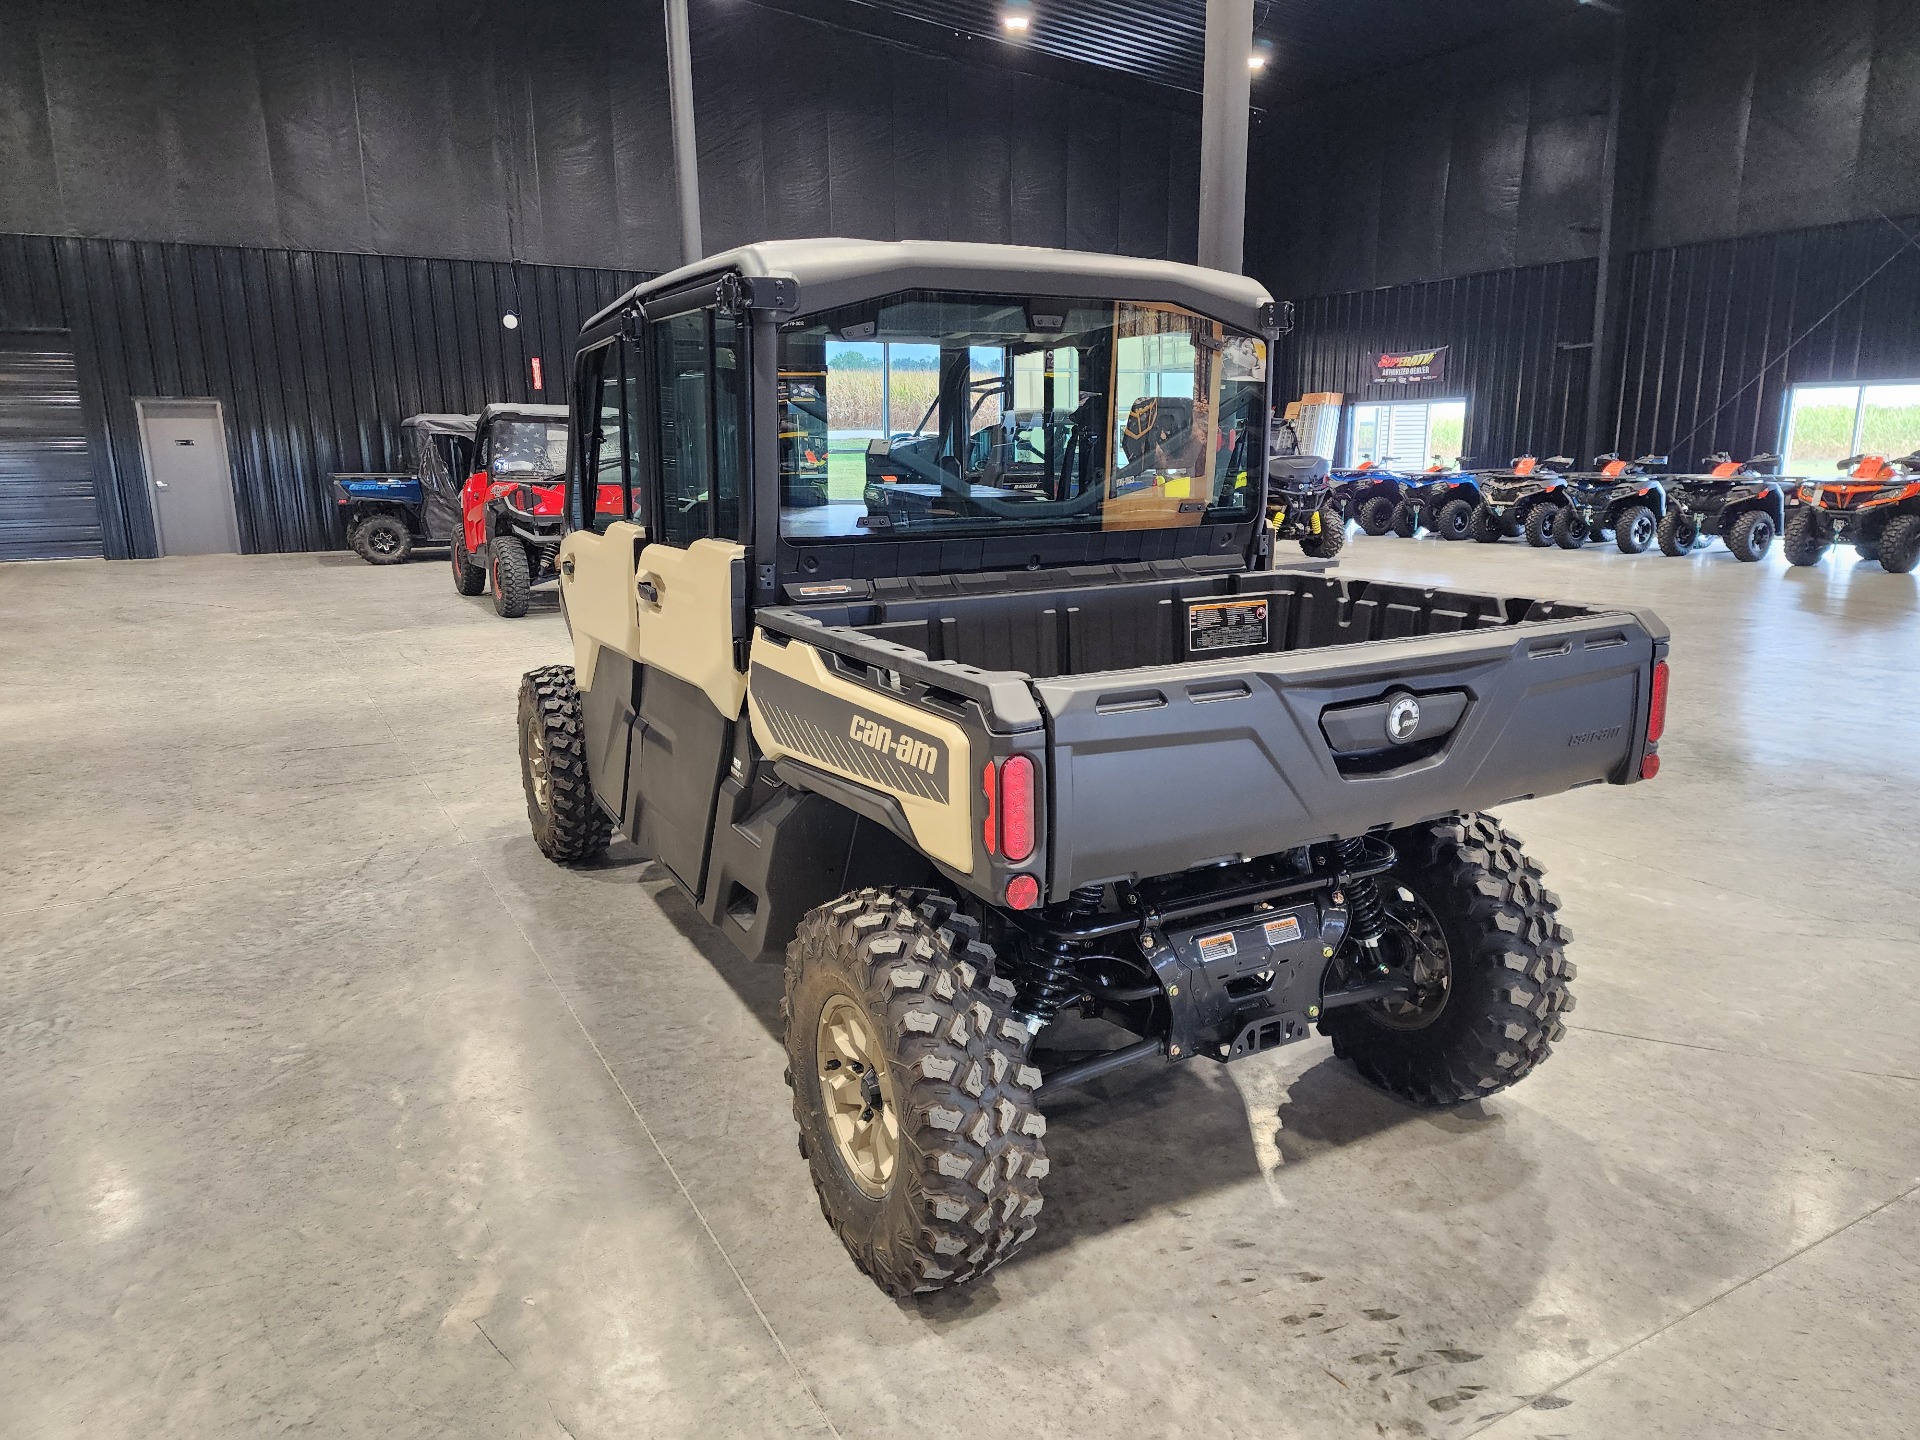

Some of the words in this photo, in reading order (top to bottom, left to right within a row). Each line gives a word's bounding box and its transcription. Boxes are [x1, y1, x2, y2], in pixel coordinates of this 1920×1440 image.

[1382, 368, 1409, 376] AUTHORIZED
[1410, 366, 1429, 374] DEALER
[1402, 718, 1418, 727] BRP
[1568, 725, 1621, 746] can-am
[850, 714, 938, 775] can-am
